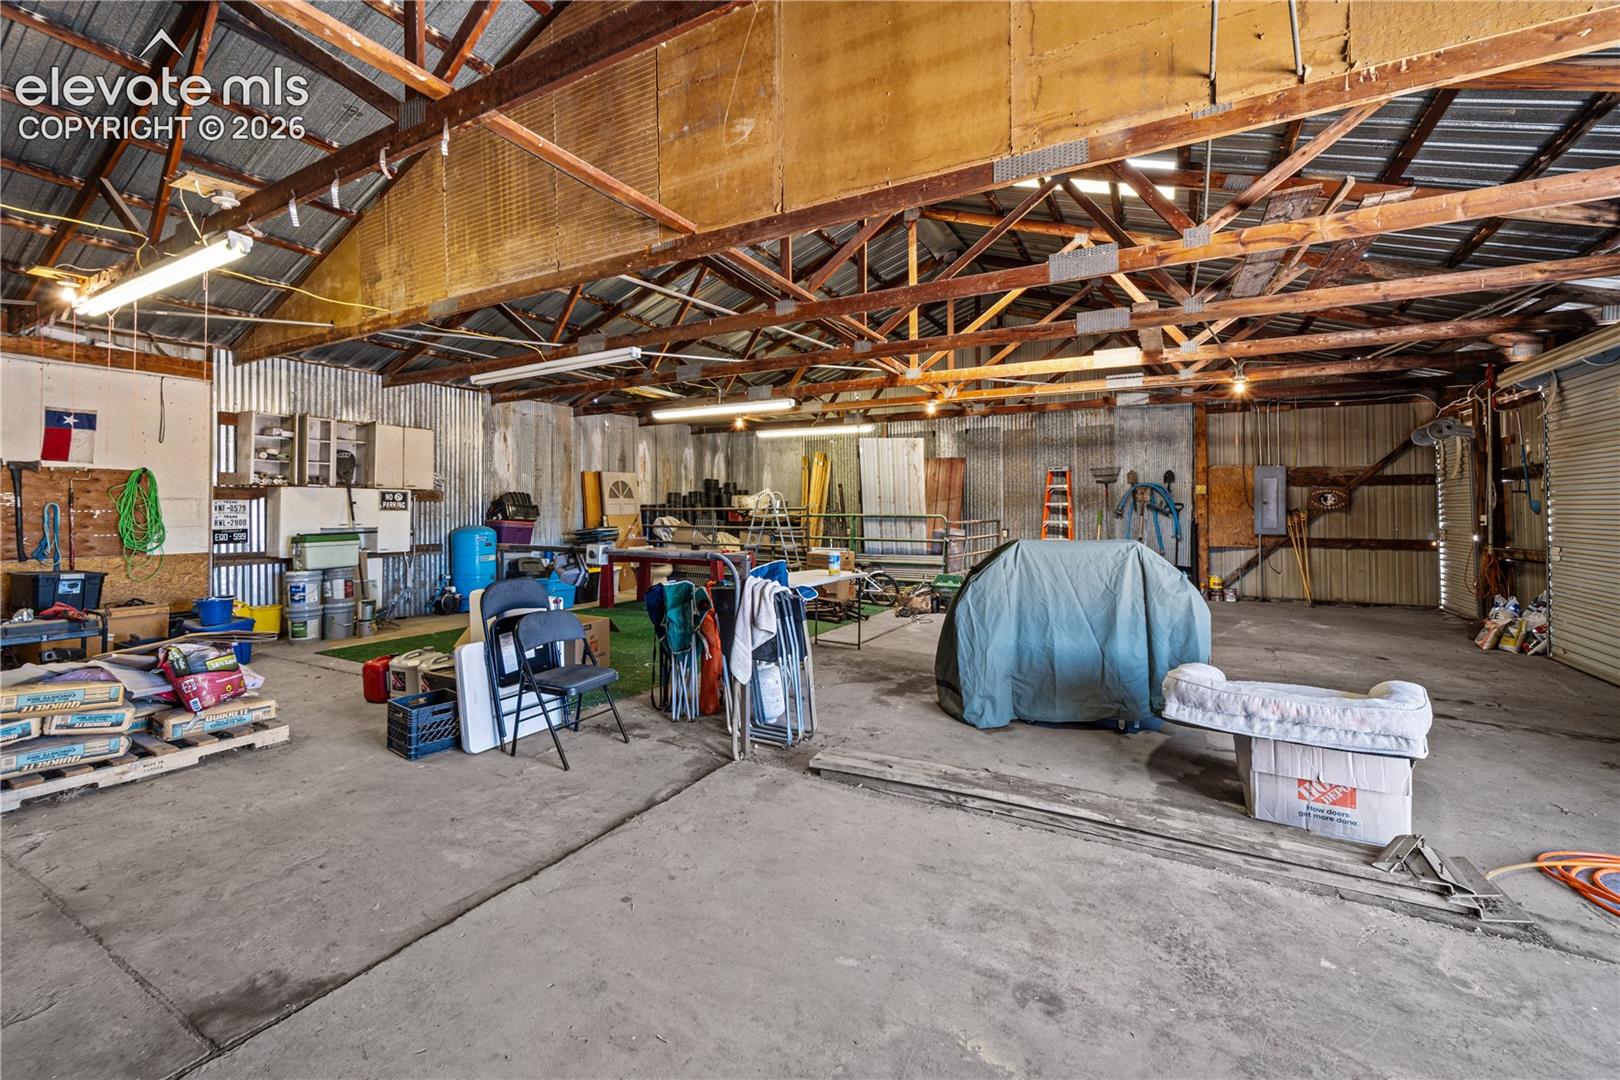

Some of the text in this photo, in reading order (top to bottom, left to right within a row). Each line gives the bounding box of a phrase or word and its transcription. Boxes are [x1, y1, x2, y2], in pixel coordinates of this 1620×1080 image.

[385, 493, 393, 501] NO
[382, 501, 406, 509] PARKING
[1298, 810, 1311, 818] get
[1313, 813, 1334, 822] more
[1306, 804, 1351, 818] How doers
